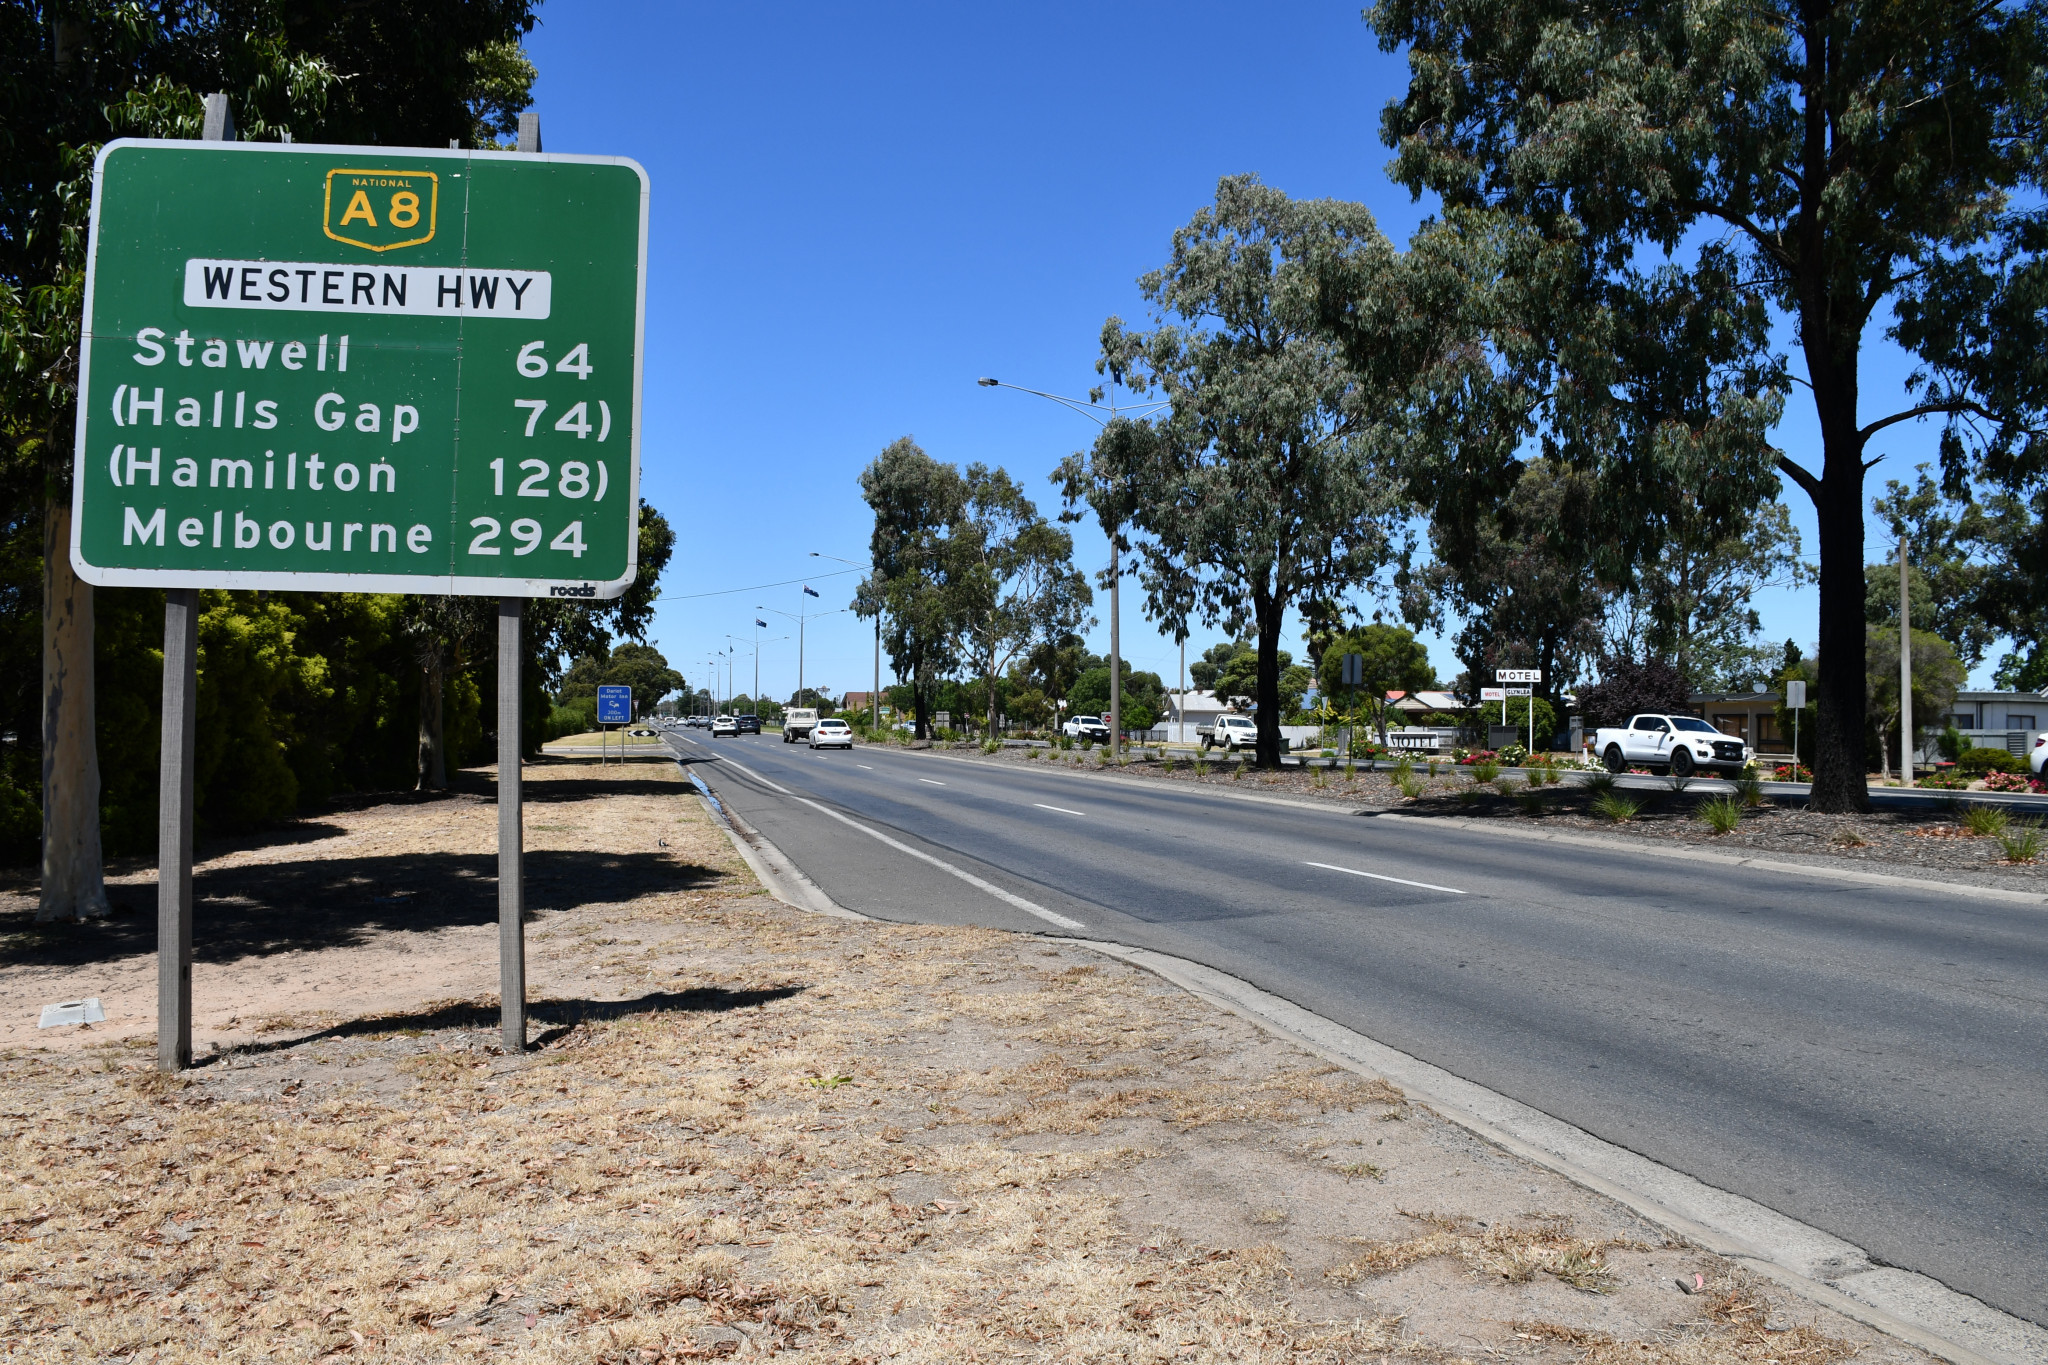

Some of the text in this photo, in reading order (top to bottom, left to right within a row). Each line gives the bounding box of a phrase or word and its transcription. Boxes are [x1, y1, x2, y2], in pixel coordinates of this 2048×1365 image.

[352, 178, 412, 188] NATIONAL
[203, 266, 534, 311] WESTERN HWY
[132, 327, 594, 380] Stawell 64
[111, 384, 612, 443] (Halls Gap 74)
[109, 444, 609, 502] (Hamilton 128)
[123, 507, 587, 558] Melbourne 294
[550, 582, 596, 597] roads
[1498, 671, 1540, 680] MOTEL
[1390, 736, 1436, 747] MOTEL
